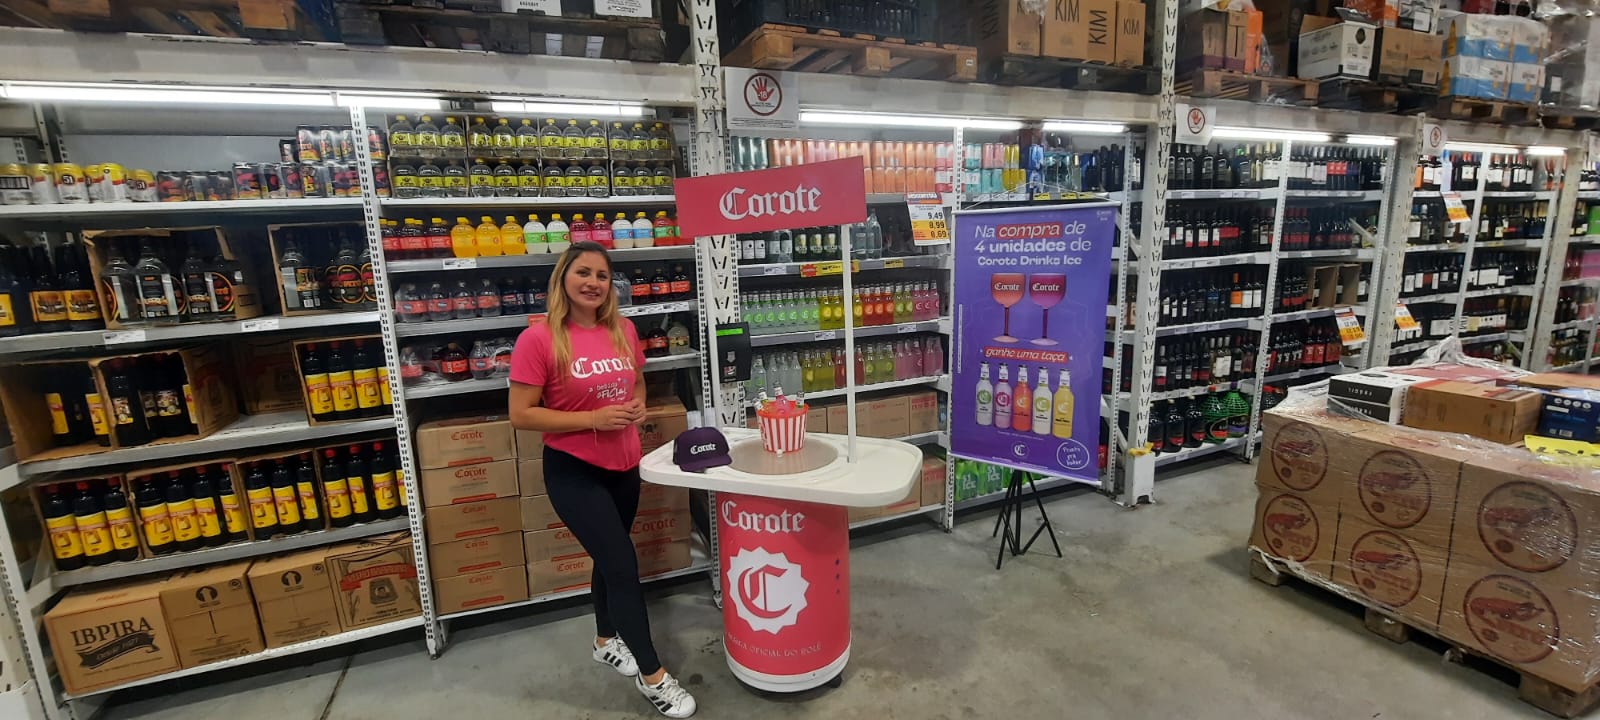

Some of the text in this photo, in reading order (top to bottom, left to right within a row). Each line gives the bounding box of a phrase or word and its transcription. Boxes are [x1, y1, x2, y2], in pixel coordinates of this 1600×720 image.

[1055, 0, 1080, 23] KIM
[1088, 9, 1107, 45] KIM
[1123, 18, 1140, 35] KIM
[62, 175, 74, 184] 51
[719, 184, 822, 221] Corote
[975, 220, 1087, 239] Na compra de
[974, 237, 1092, 253] 4 unidades de
[977, 254, 1082, 266] Corote Drinks Ice
[994, 282, 1021, 291] Corote
[1032, 282, 1060, 292] Corote
[985, 347, 1066, 362] ganhe uma taça
[450, 431, 485, 441] Corote
[690, 443, 717, 455] Corote
[455, 468, 488, 478] Corote
[722, 500, 805, 534] Corote
[557, 561, 585, 571] Corote
[70, 616, 155, 647] IBPIRA
[750, 646, 781, 657] OFICIAL
